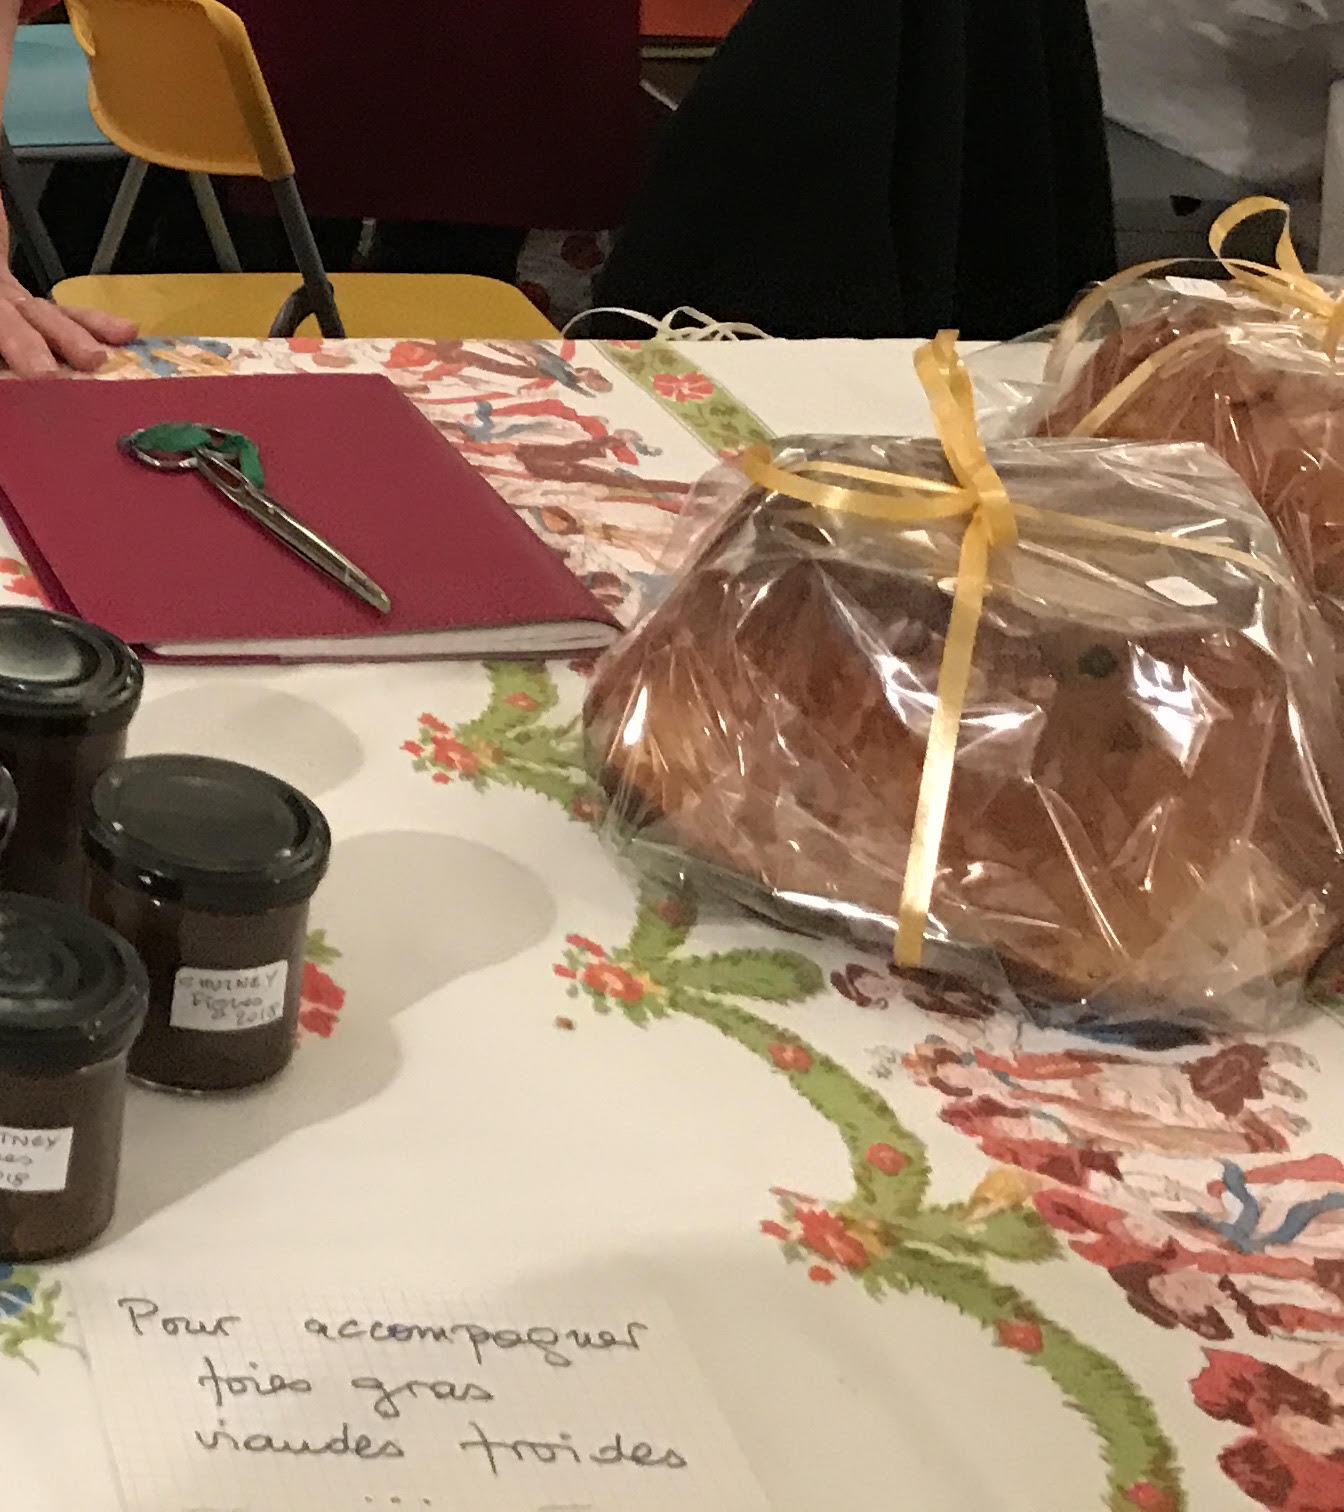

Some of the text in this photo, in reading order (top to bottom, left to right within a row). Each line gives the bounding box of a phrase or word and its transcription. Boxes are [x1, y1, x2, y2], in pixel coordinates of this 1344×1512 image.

[117, 1297, 650, 1367] Pour accompagner
[350, 1374, 496, 1418] gras
[194, 1419, 406, 1460] viandes
